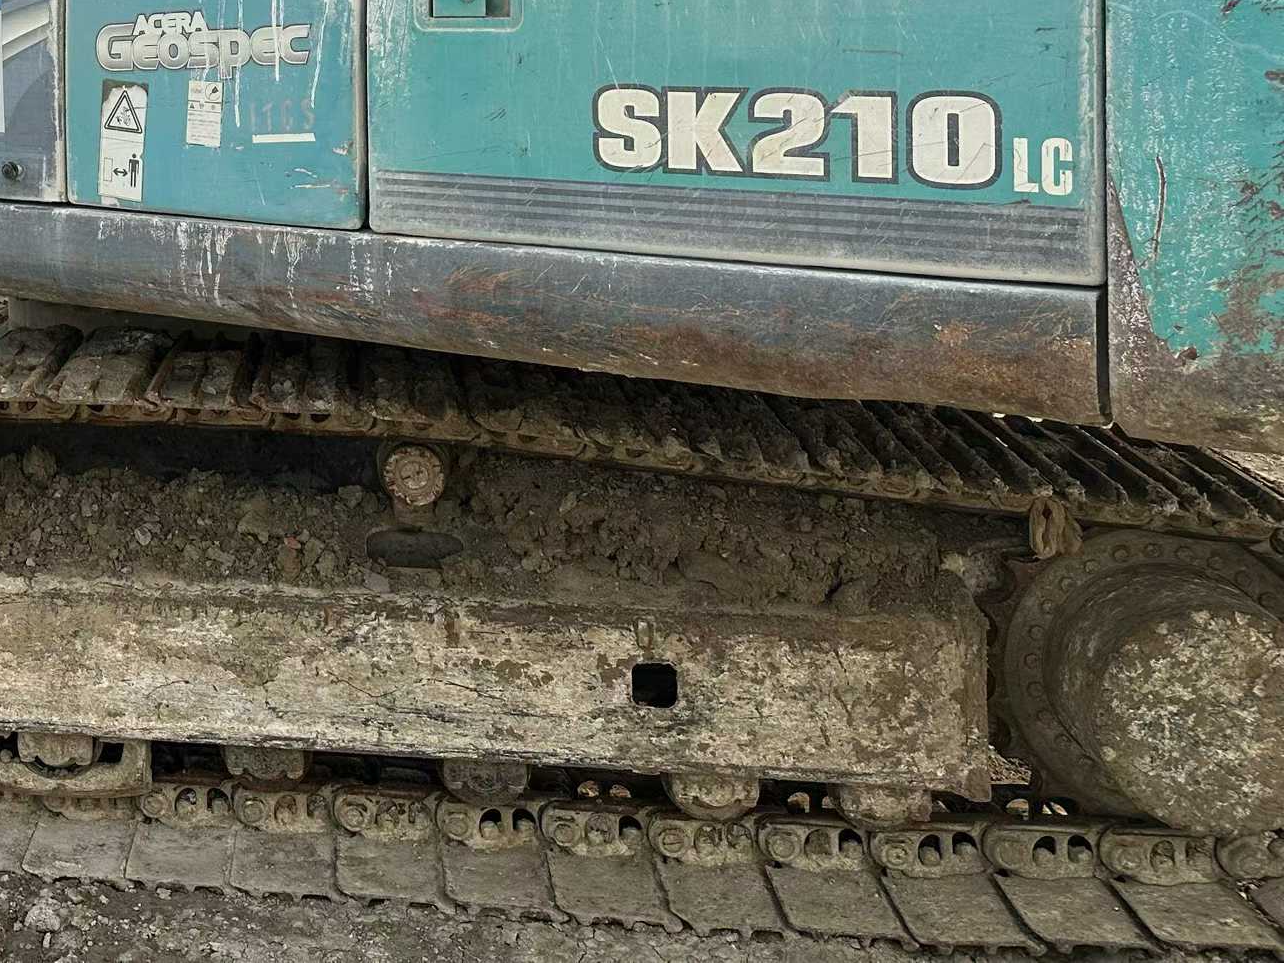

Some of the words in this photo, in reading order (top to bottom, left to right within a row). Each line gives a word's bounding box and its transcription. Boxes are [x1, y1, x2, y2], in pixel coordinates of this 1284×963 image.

[132, 10, 209, 35] ACERA
[593, 84, 1002, 189] SK210
[1013, 137, 1074, 196] LC
